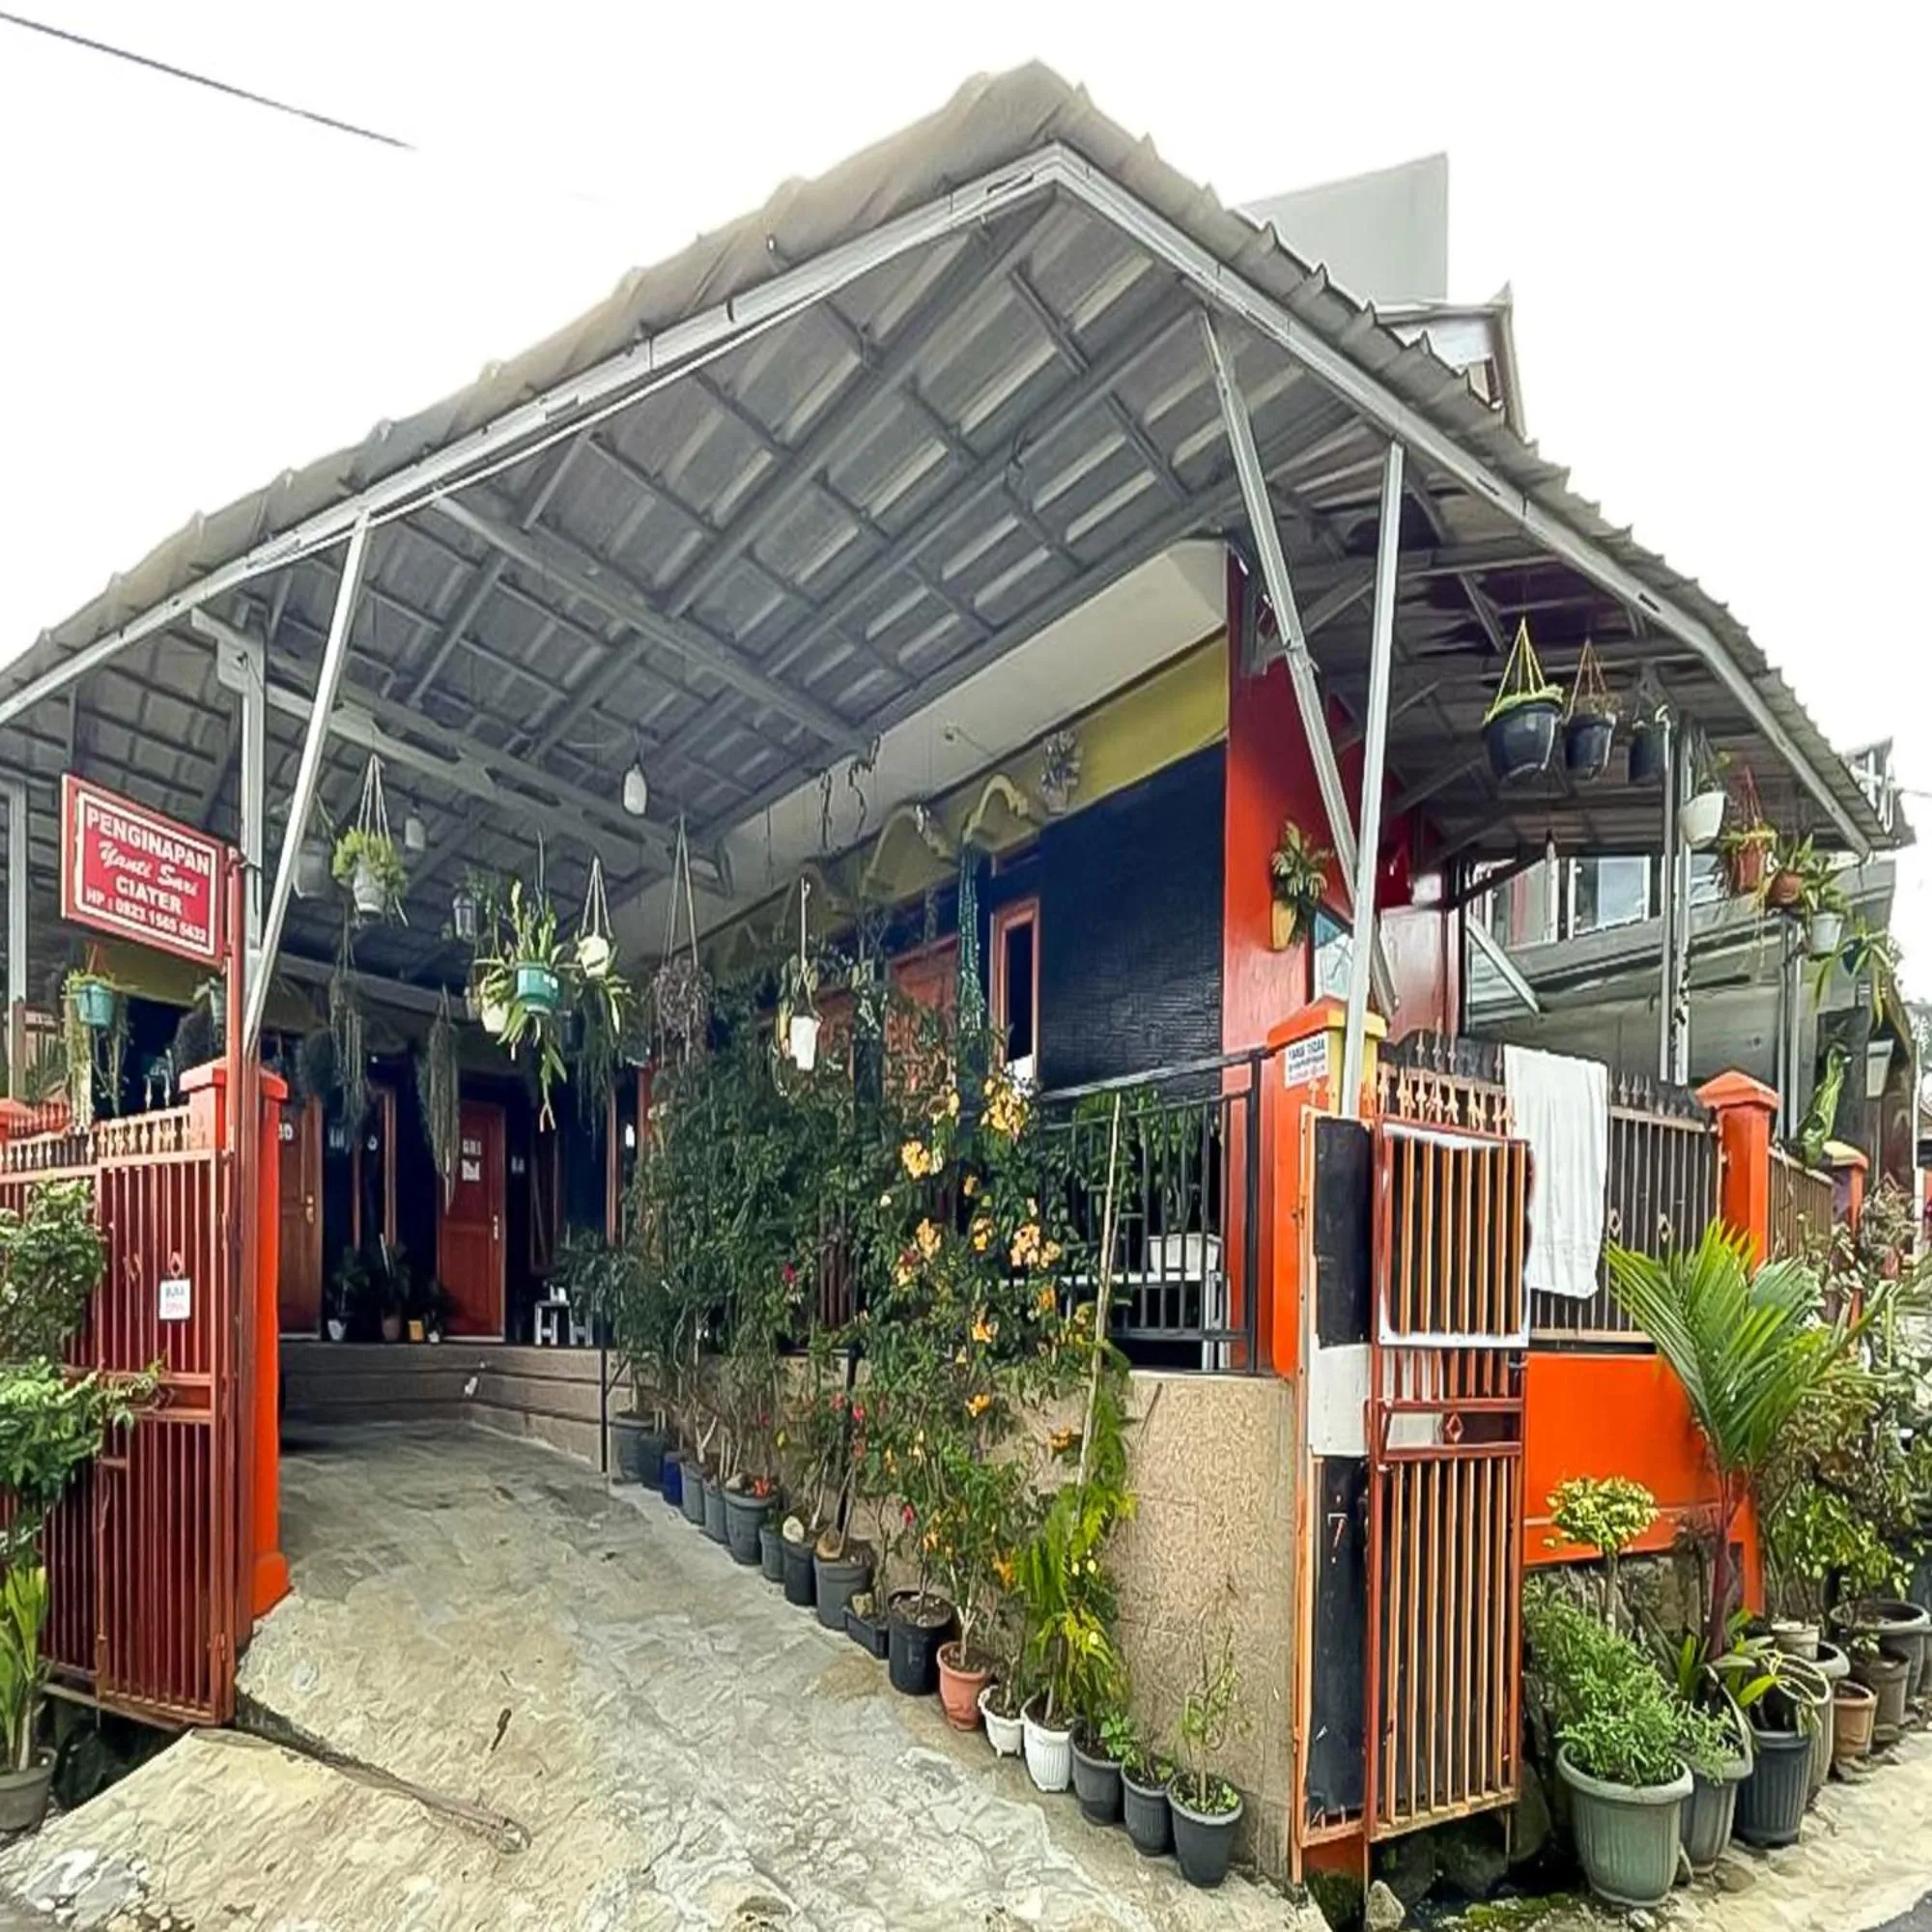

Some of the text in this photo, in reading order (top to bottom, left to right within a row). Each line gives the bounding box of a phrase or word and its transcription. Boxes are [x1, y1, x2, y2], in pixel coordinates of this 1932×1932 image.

[86, 805, 210, 875] PENGINAPAN
[85, 885, 105, 906] HP
[115, 876, 182, 916] CIATER
